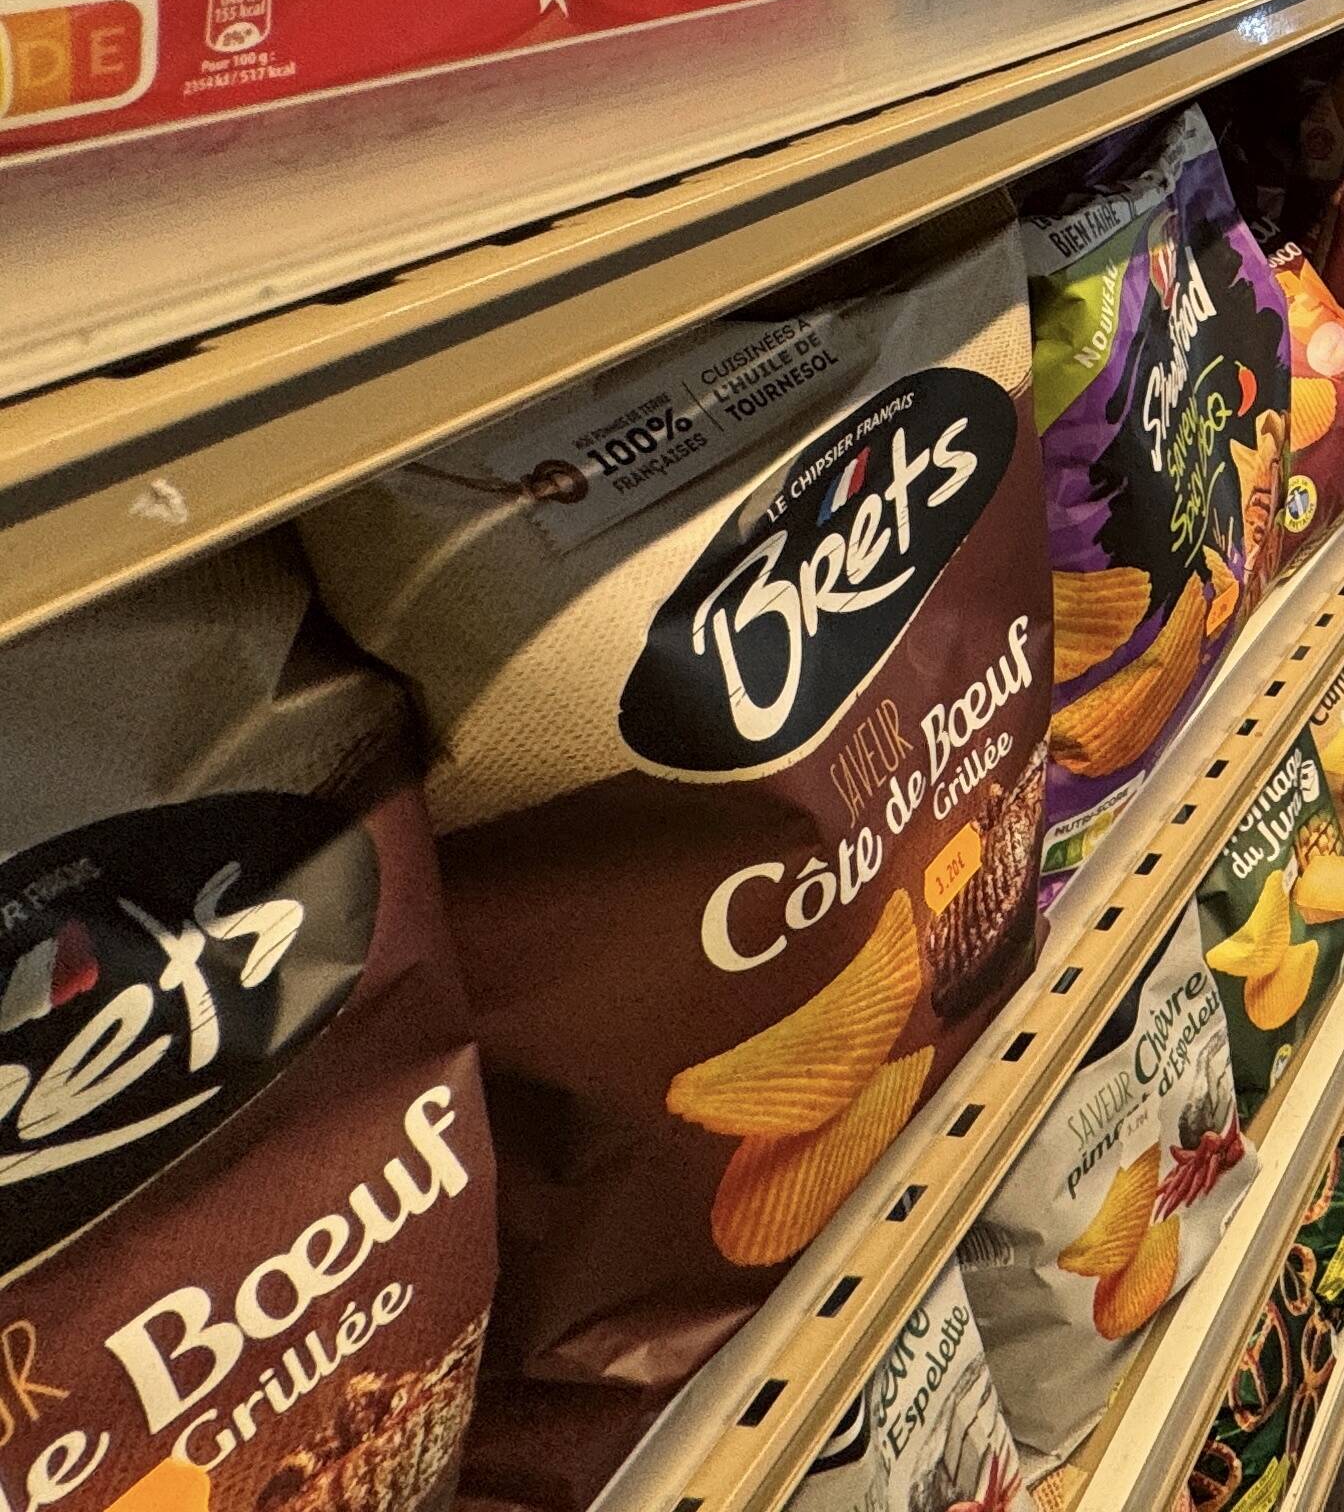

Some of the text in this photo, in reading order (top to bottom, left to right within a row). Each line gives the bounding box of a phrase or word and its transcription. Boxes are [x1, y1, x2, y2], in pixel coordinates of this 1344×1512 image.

[1050, 228, 1091, 258] BIEN
[701, 325, 795, 385] CUISINÉES
[712, 332, 822, 403] L'HUILE DE
[725, 349, 839, 421] TOURNESOL
[587, 408, 693, 476] 100%
[612, 431, 708, 494] FRANÇAISES
[766, 495, 788, 523] LE
[791, 433, 853, 499] CHIPSIER
[691, 417, 978, 742] Brets
[921, 615, 1033, 786] Bœuf
[830, 698, 914, 829] SAVEUR
[933, 732, 1013, 821] Grillée
[1222, 746, 1303, 856] omage
[701, 770, 926, 972] Côte de
[936, 854, 965, 896] 3.20€
[1231, 845, 1265, 880] du
[1135, 971, 1207, 1085] Chèvre
[1068, 1071, 1133, 1145] SAVEUR
[104, 1085, 470, 1436] Bœuf
[172, 1281, 413, 1472] Grillée
